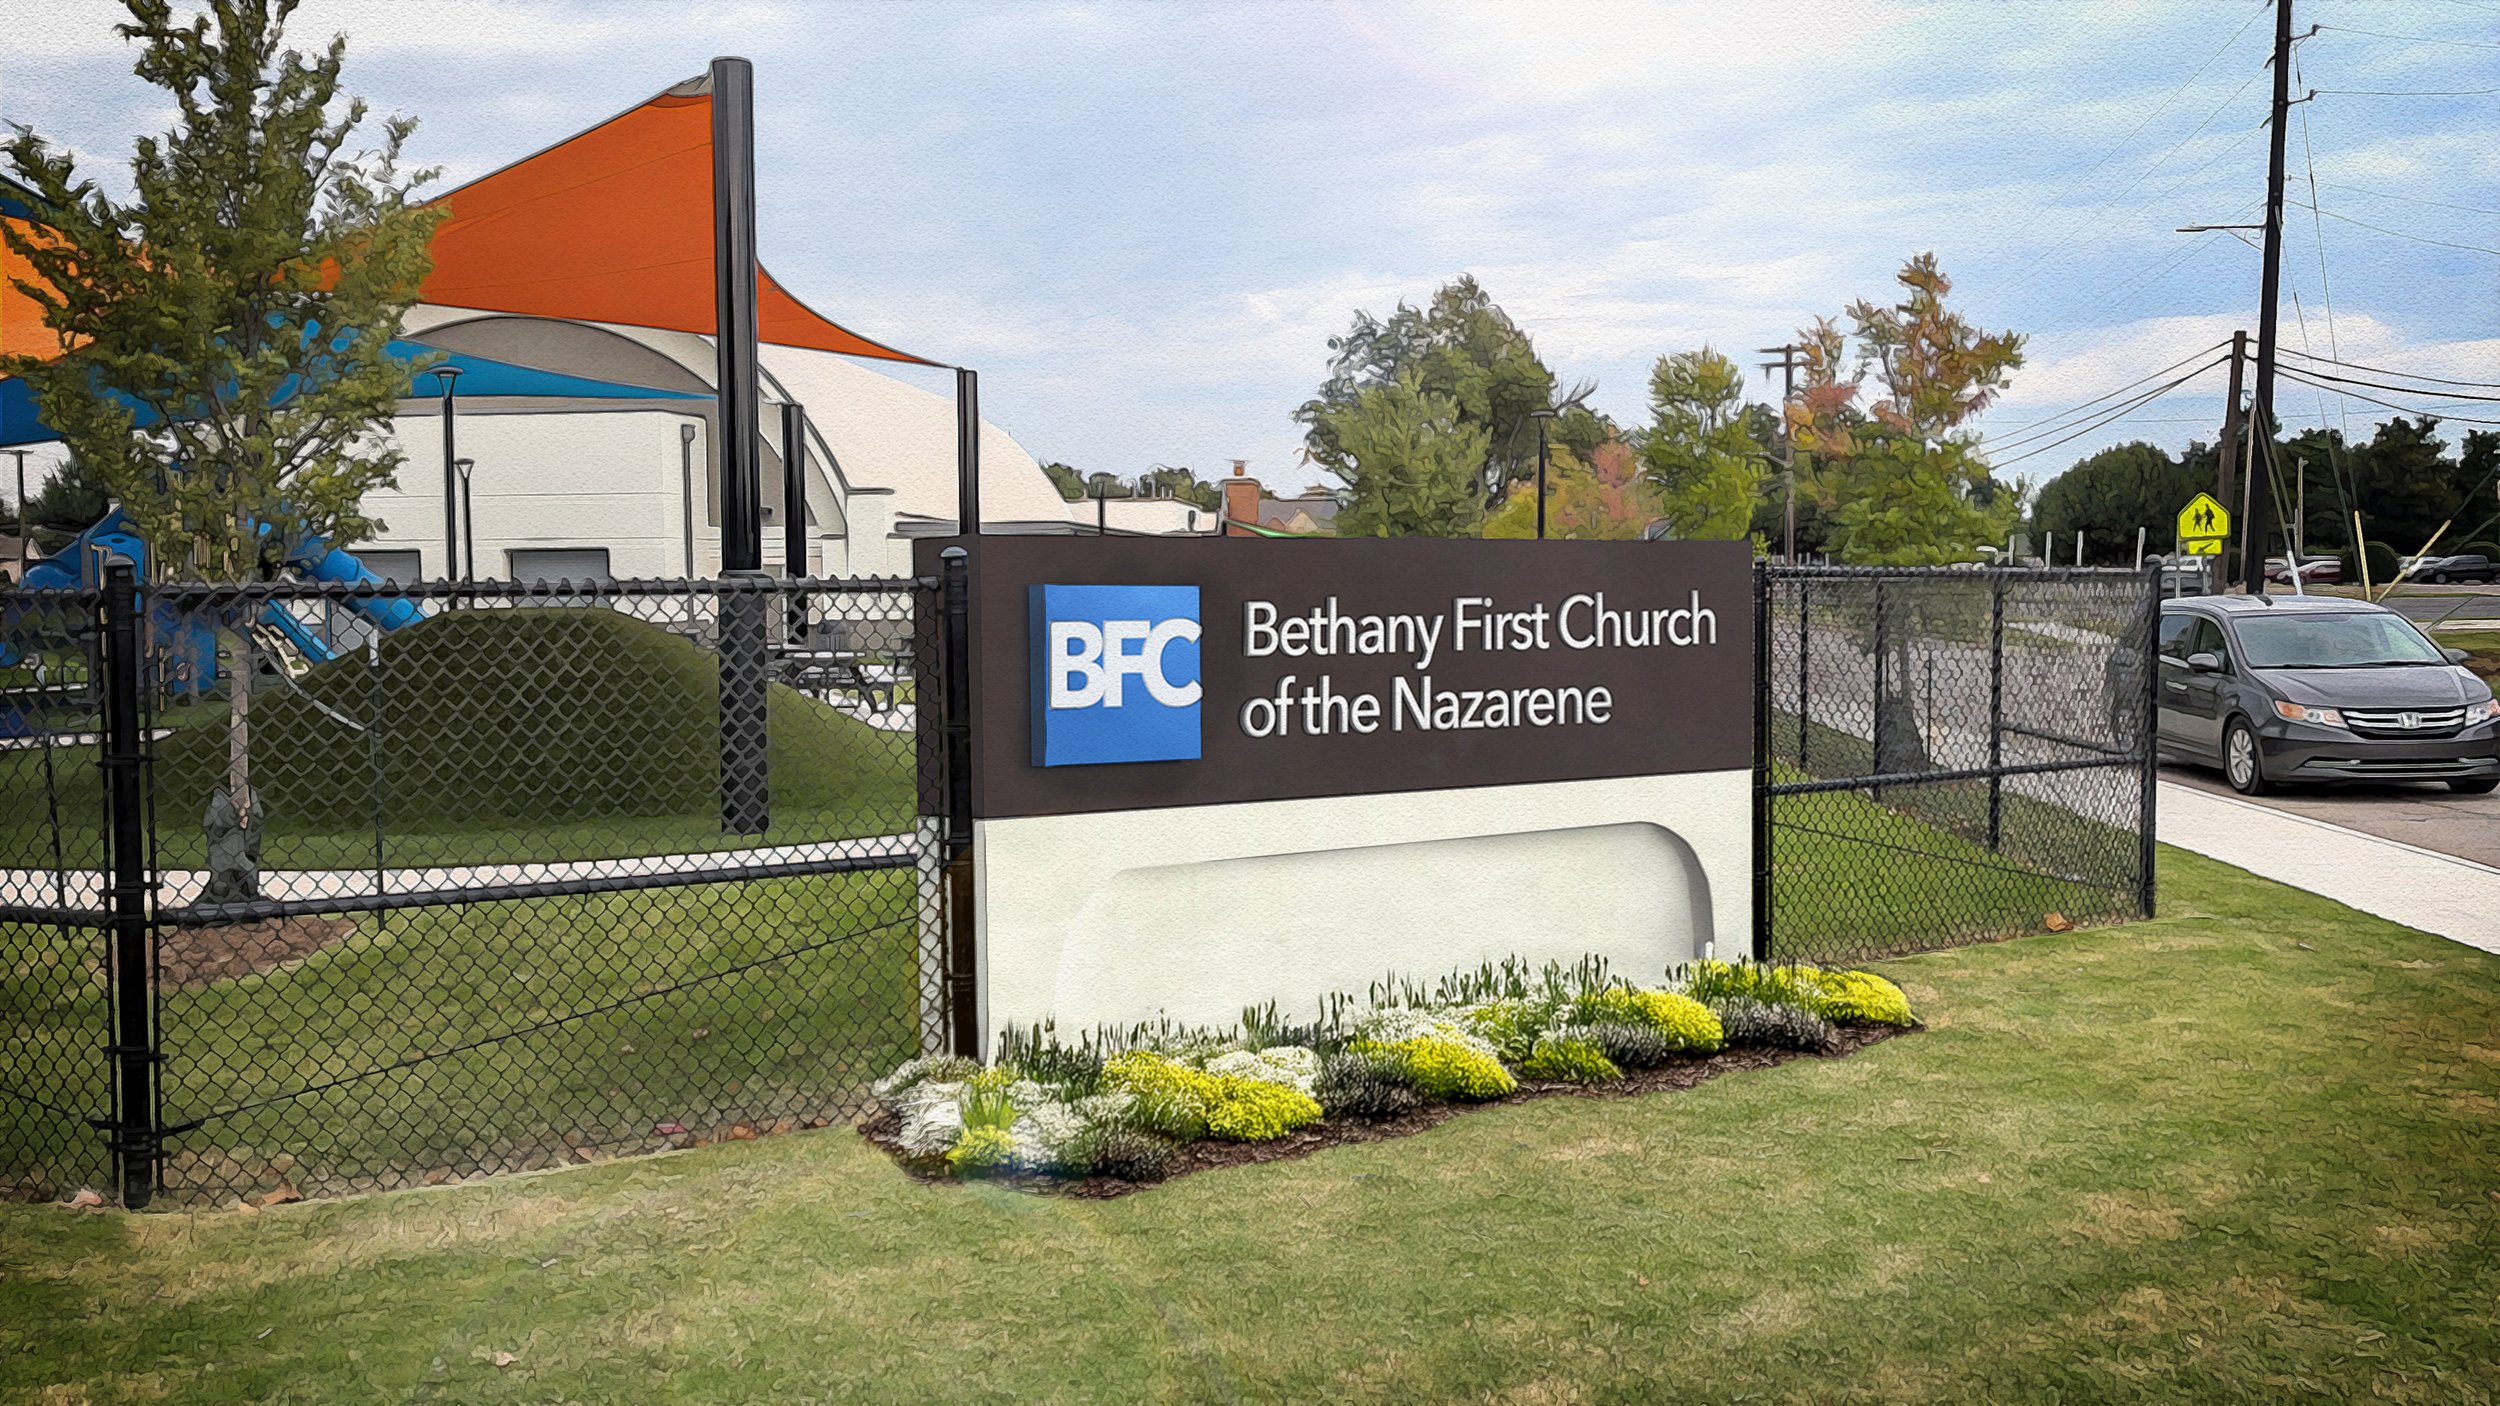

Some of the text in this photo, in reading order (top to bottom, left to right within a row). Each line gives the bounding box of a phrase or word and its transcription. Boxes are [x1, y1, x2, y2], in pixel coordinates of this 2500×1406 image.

[1049, 618, 1203, 709] BFC
[1243, 590, 1717, 670] Bethany First Church
[1239, 675, 1613, 738] of the Nazarene
